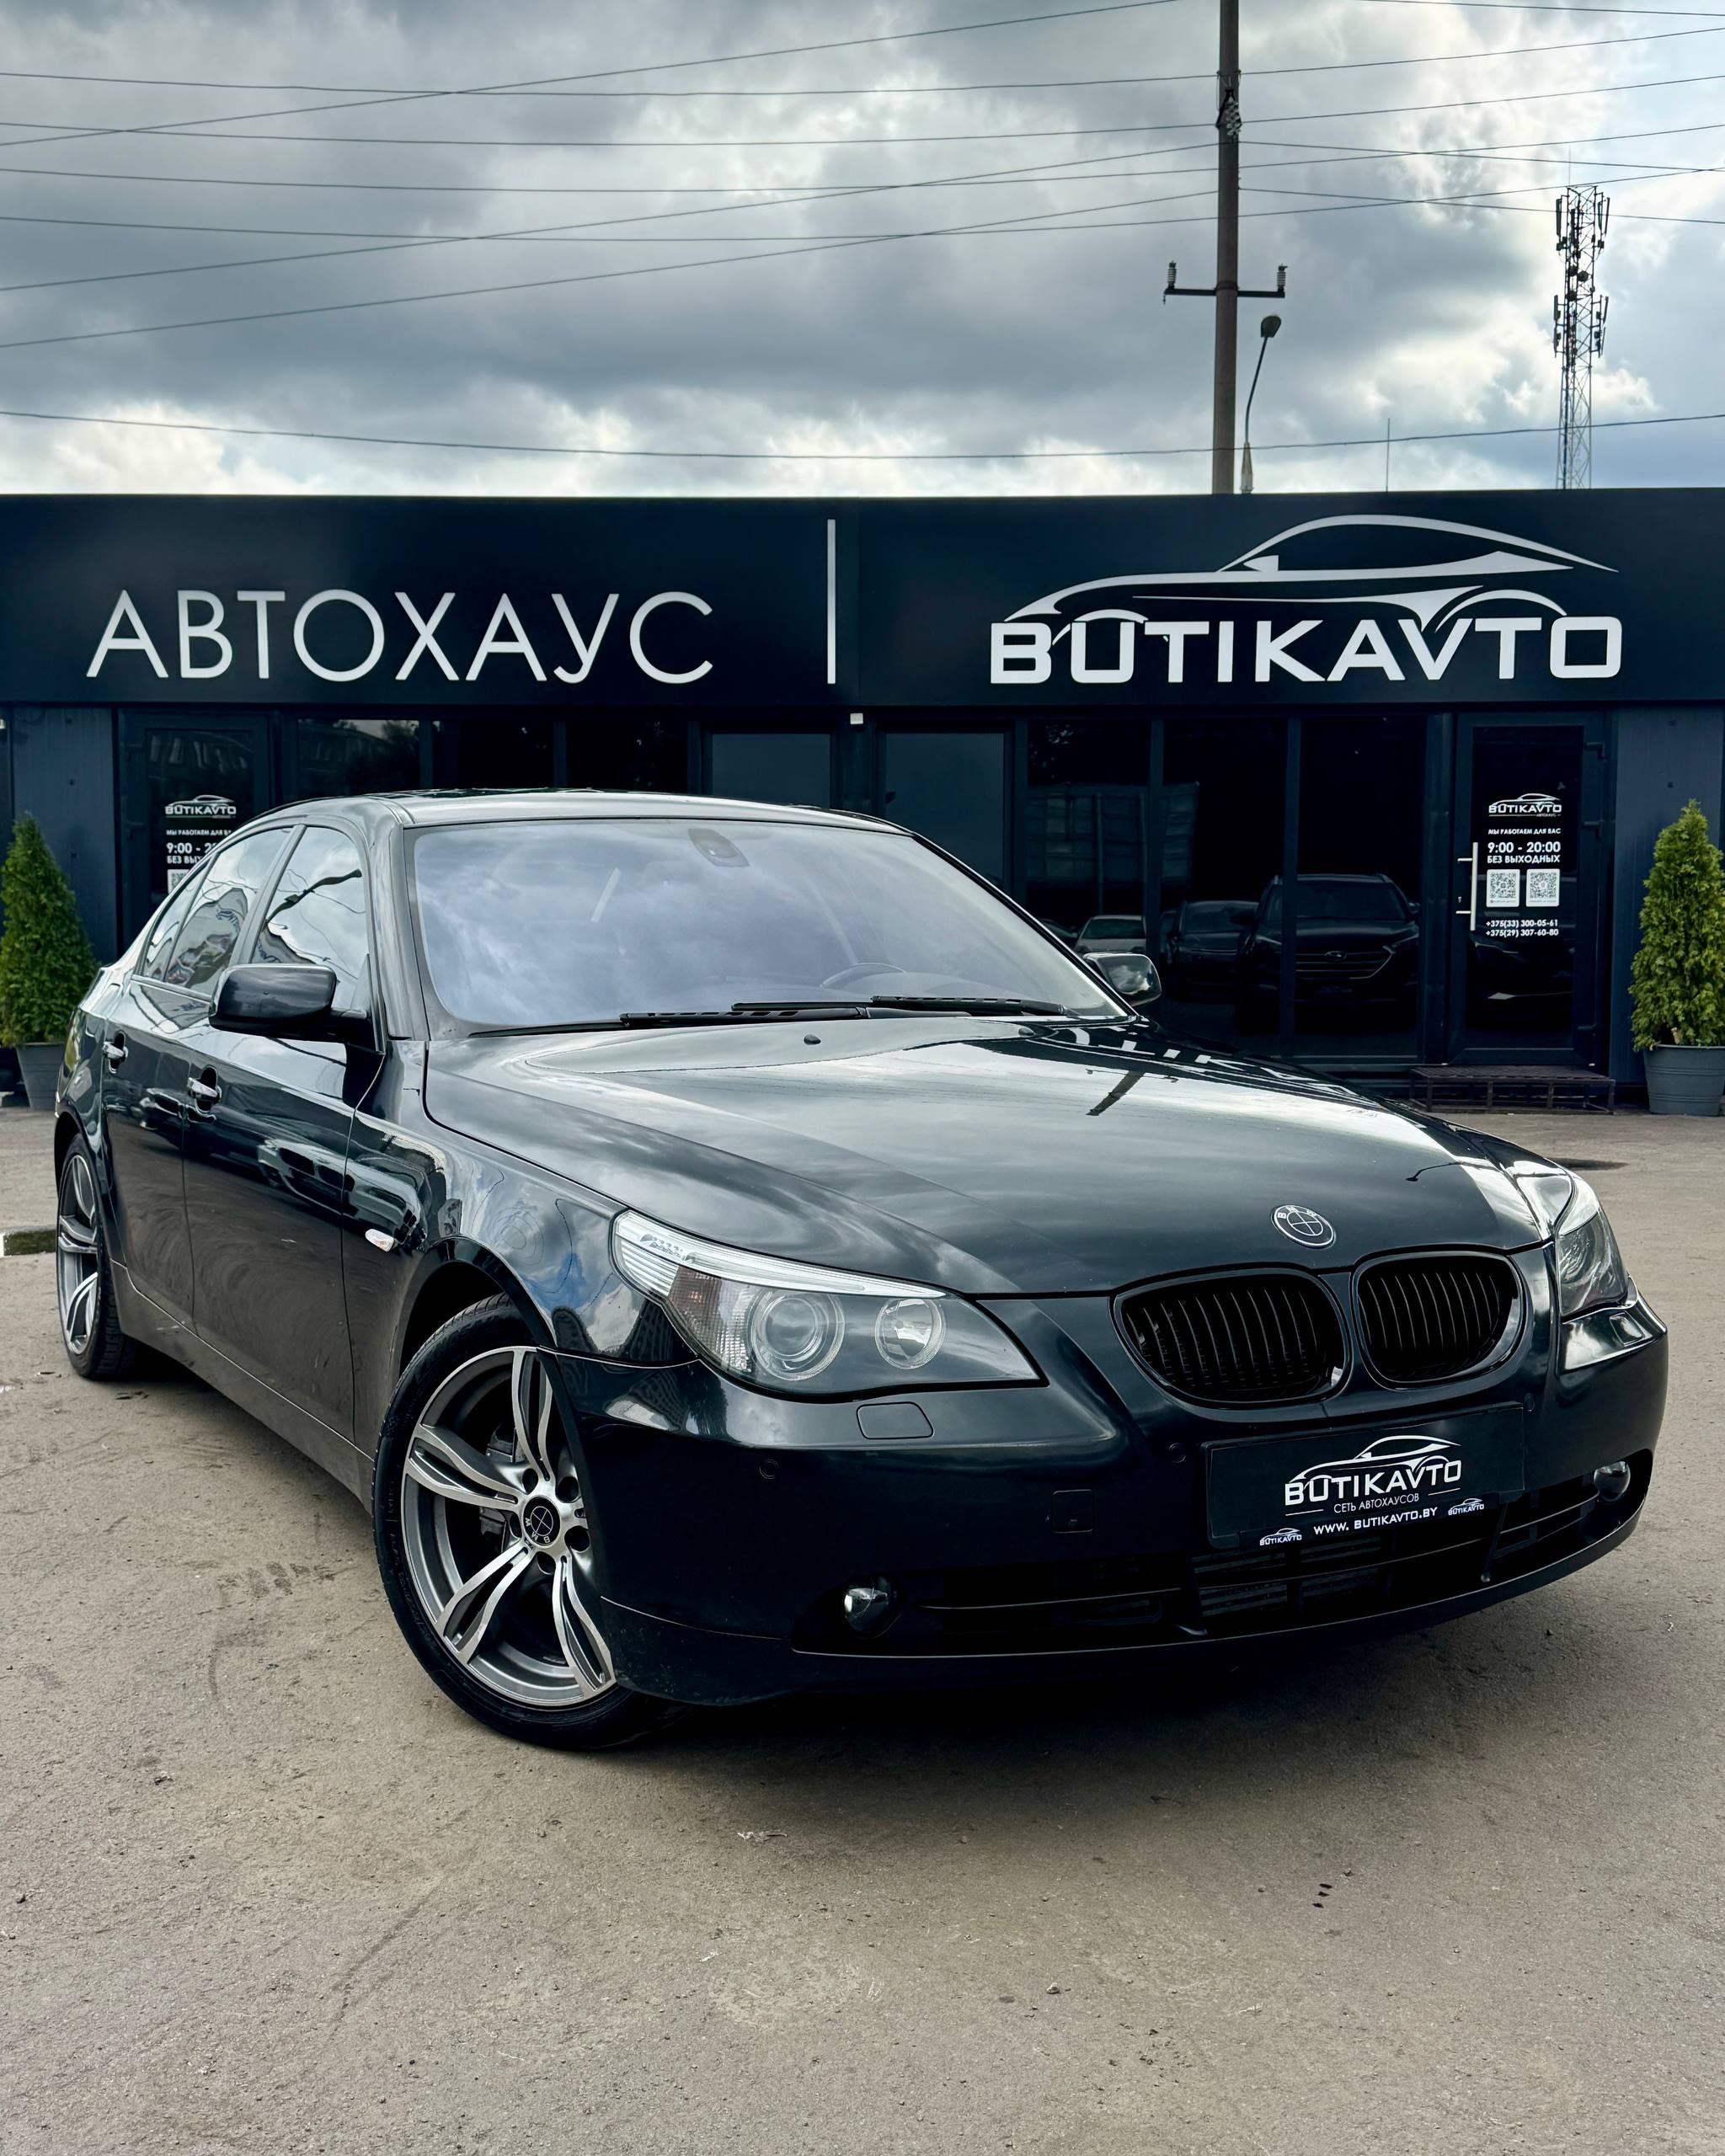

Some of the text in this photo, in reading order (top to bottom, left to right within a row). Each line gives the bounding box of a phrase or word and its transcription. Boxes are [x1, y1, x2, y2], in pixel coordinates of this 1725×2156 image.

[86, 589, 713, 684] АВТОХАУС
[991, 616, 1622, 684] BUTIKAVTO
[164, 806, 237, 814] BUTIKAVTO
[1488, 804, 1562, 813] BUTIKAVTO
[166, 842, 192, 854] 9:00
[1487, 841, 1514, 853] 9:00
[1526, 841, 1562, 852] 20:00
[167, 856, 182, 864] БЕЗ
[1487, 855, 1561, 863] БЕЗ ВЫХОДНЫХ
[1486, 920, 1519, 928] +375(33)
[1486, 929, 1519, 938] +375(29)
[1284, 1460, 1462, 1506] BUTIKAVTO
[1333, 1493, 1420, 1513] СЕТЬ АВТОХАУСОВ
[1448, 1502, 1485, 1516] BUTIKAVTO
[1313, 1507, 1438, 1535] WWW. BUTIKAVTO.BY
[1259, 1534, 1302, 1546] BUTIKAVTO
